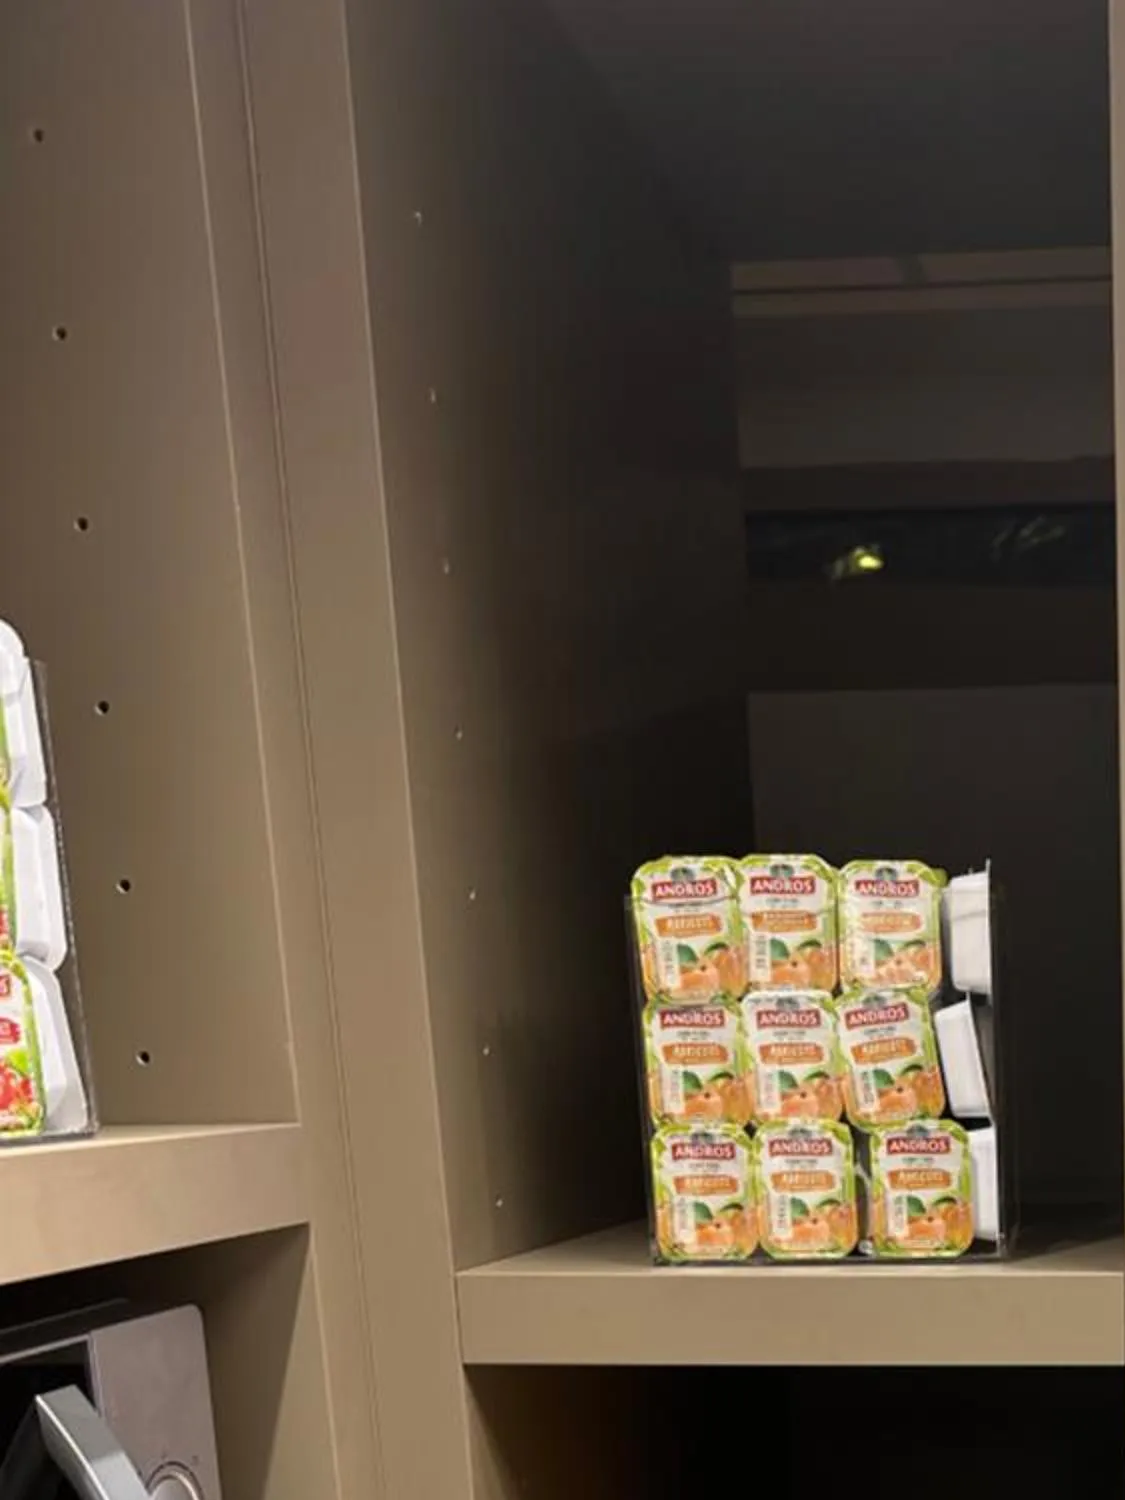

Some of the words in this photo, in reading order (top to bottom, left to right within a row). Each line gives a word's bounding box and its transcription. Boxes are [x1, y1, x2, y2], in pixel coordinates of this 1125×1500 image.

[656, 880, 713, 896] ANDROS
[752, 878, 813, 892] ANDROS
[857, 881, 916, 896] ANDROS
[663, 1012, 722, 1026] ANDROS
[759, 1012, 818, 1026] ANDROS
[849, 1006, 906, 1025] ANDROS
[674, 1144, 733, 1158] ANDROS
[770, 1140, 831, 1154] ANDROS
[889, 1139, 948, 1153] ANDROS
